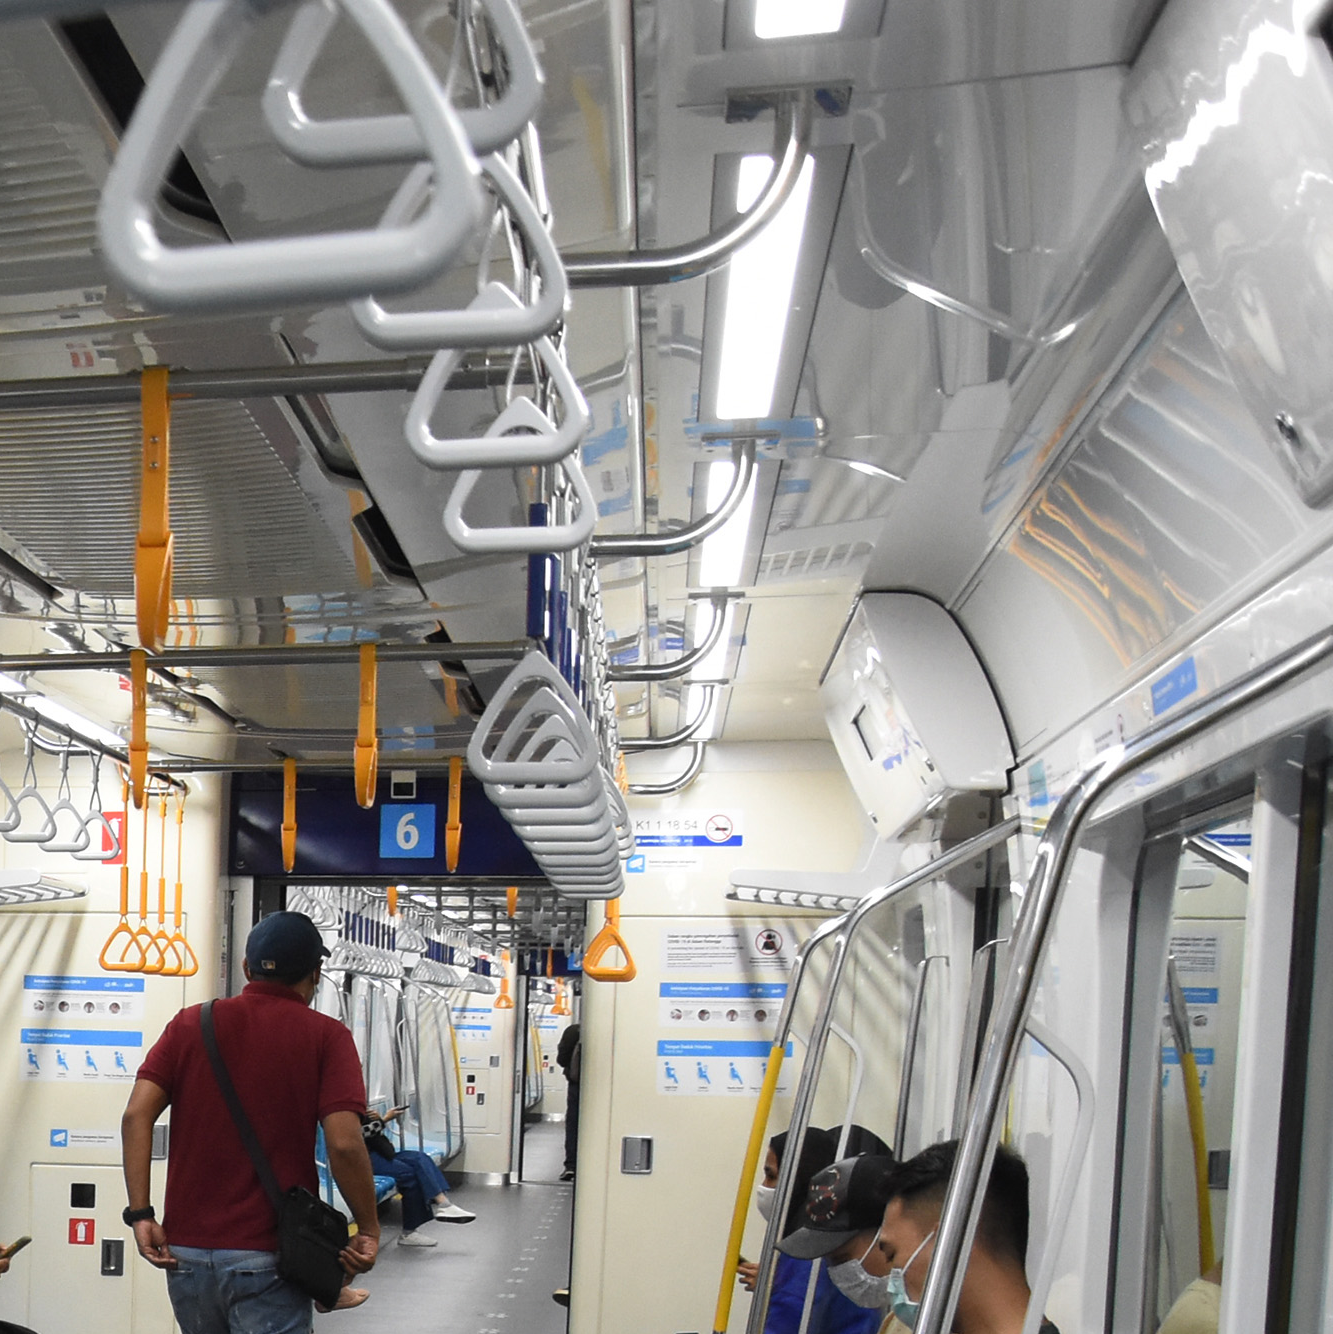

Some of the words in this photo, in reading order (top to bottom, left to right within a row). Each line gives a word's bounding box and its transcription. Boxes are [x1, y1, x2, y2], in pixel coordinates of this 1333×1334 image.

[396, 812, 419, 850] 6
[635, 820, 650, 830] K1
[667, 820, 680, 830] 18
[684, 820, 698, 830] 54
